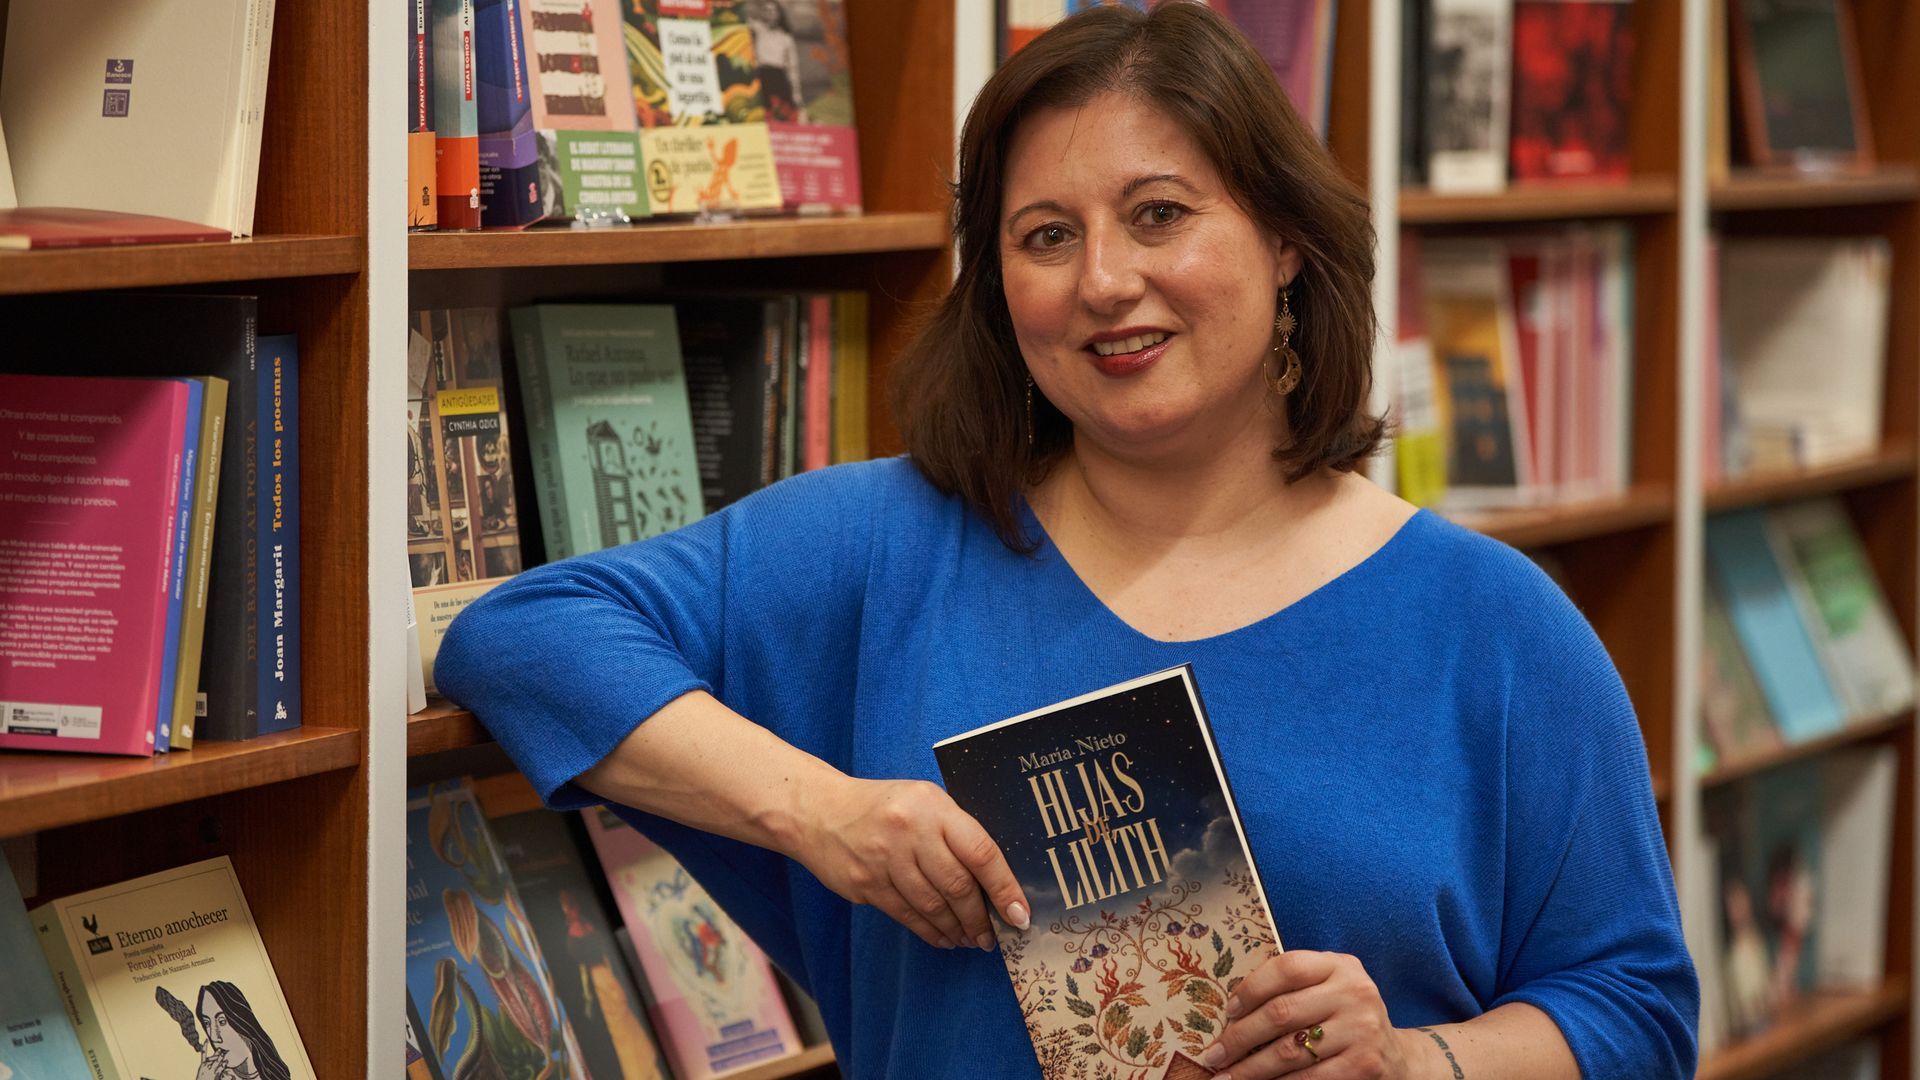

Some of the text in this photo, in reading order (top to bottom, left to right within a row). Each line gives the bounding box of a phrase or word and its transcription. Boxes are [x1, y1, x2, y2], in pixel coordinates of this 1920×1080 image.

[442, 394, 496, 408] ANTIGÜEDADES
[272, 356, 284, 532] Todos los poemas
[448, 418, 498, 432] CYNTHIA OZICK
[247, 420, 257, 661] DEL BARRO AL POEMA
[273, 544, 285, 682] Joan Margarit
[1018, 732, 1126, 773] María Nieto
[1027, 751, 1145, 838] HIJAS
[1083, 816, 1111, 846] DE
[1046, 818, 1170, 910] LILITH
[116, 925, 163, 948] Eterno
[165, 908, 228, 936] anochecer
[127, 944, 197, 973] Forugh Farrojzad
[140, 943, 164, 956] completa
[132, 972, 163, 984] Traducción
